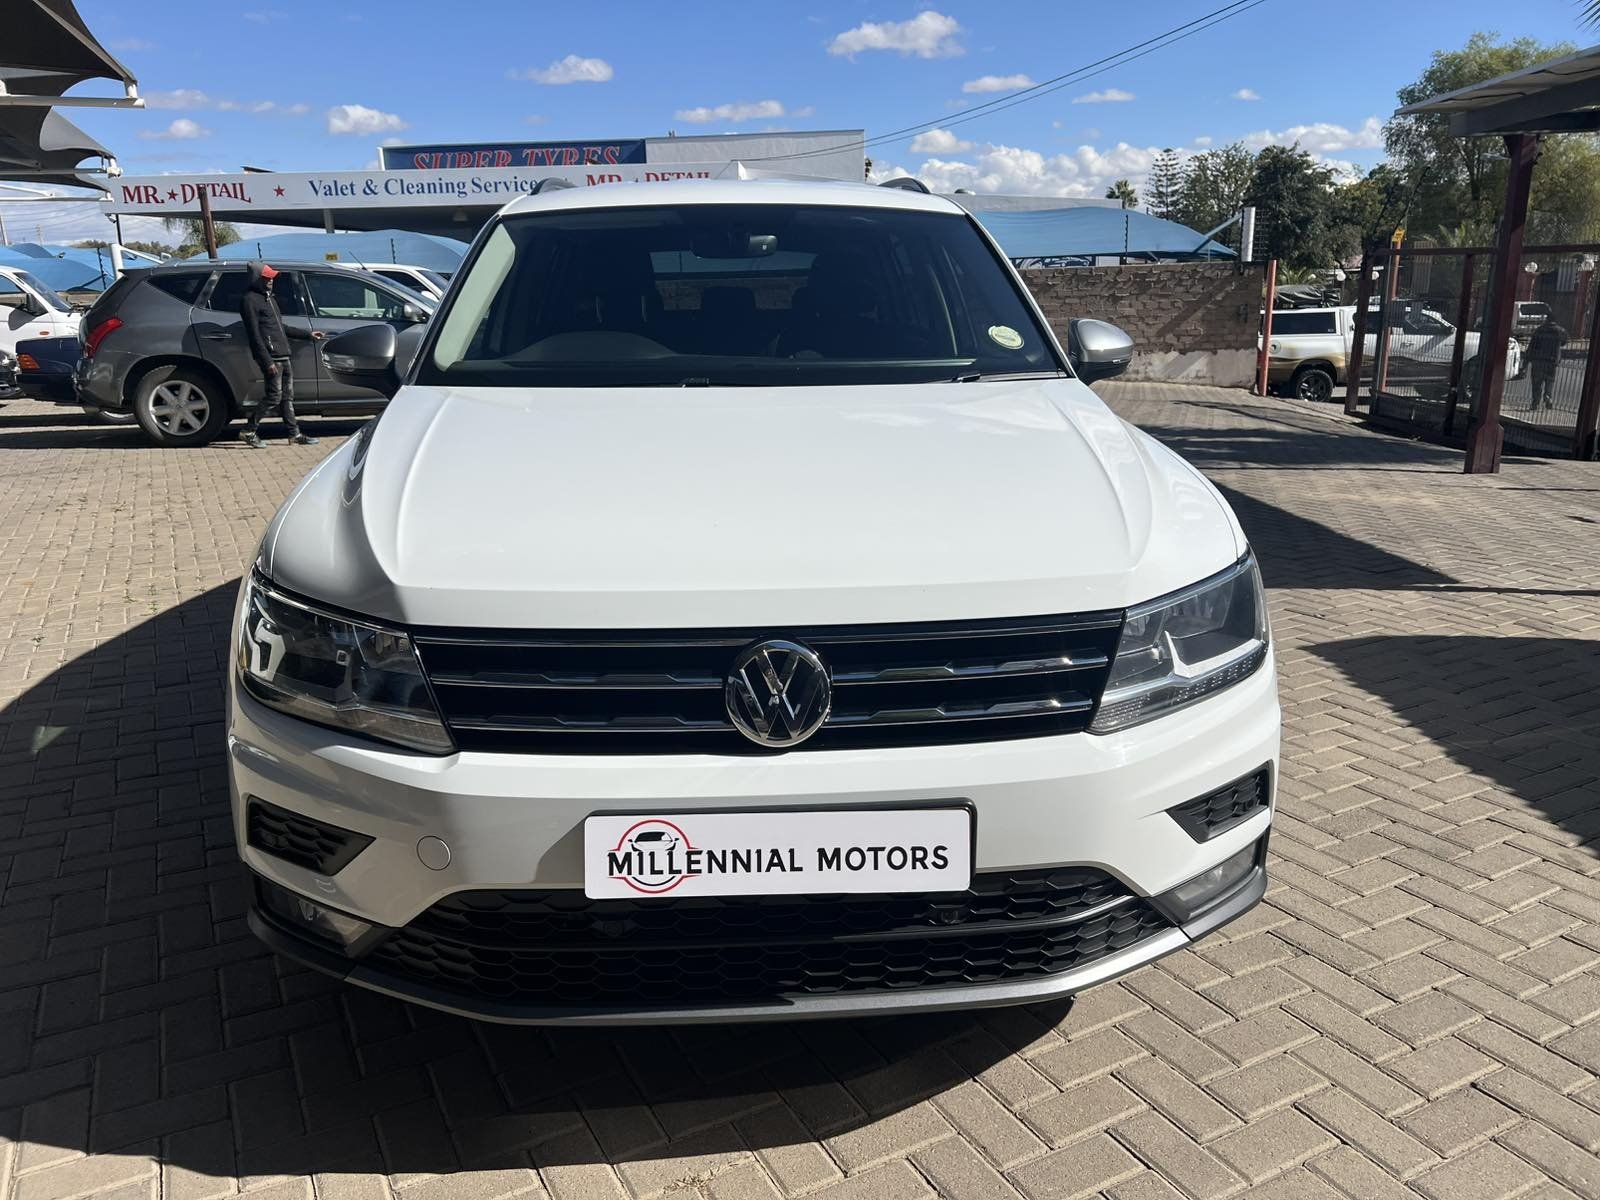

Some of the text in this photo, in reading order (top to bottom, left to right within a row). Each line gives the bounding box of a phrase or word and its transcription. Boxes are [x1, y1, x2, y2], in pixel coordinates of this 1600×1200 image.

[414, 145, 620, 170] SUPER TYRES
[121, 184, 165, 205] MR.
[308, 179, 356, 197] Valet
[362, 178, 379, 196] &
[384, 176, 468, 199] Cleaning
[607, 844, 950, 877] MILLENNIAL MOTORS
